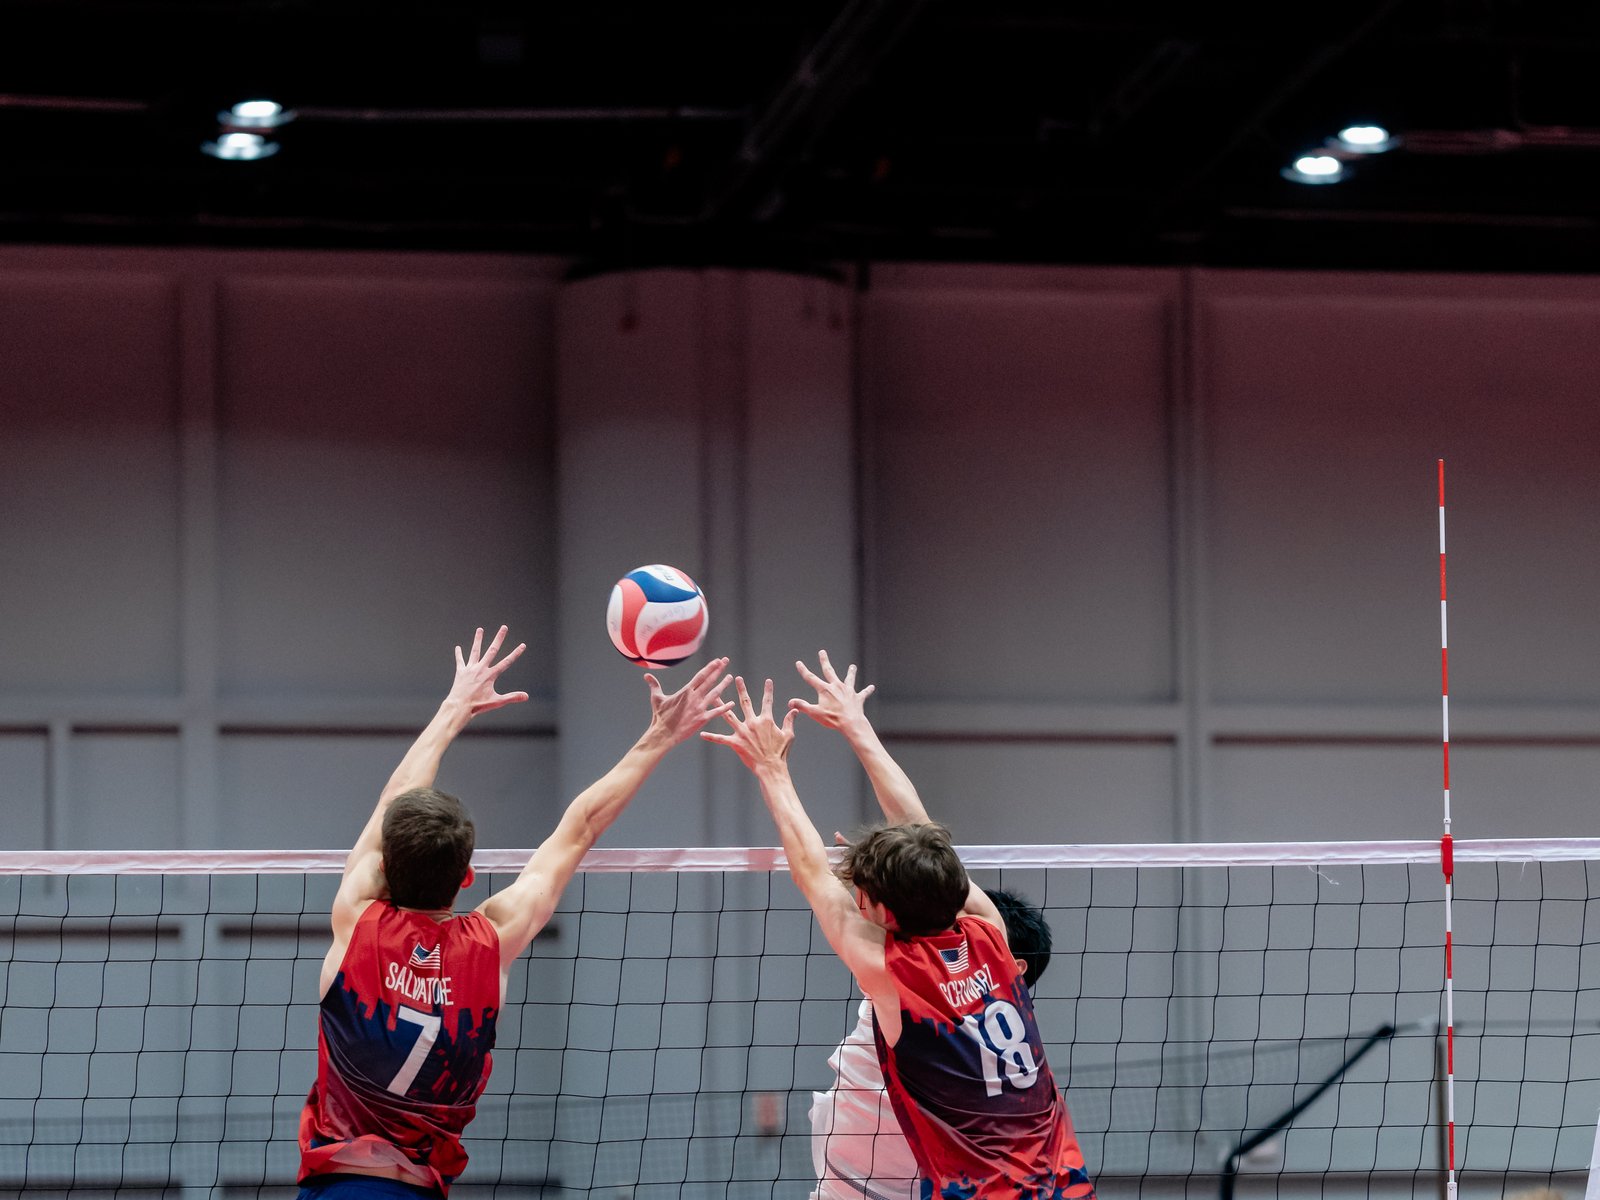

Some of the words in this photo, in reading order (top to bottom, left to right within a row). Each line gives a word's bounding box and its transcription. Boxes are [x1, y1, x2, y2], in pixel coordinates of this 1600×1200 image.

[385, 961, 454, 1006] SALVATORE
[386, 1005, 442, 1097] 7
[959, 1000, 1039, 1098] 18
